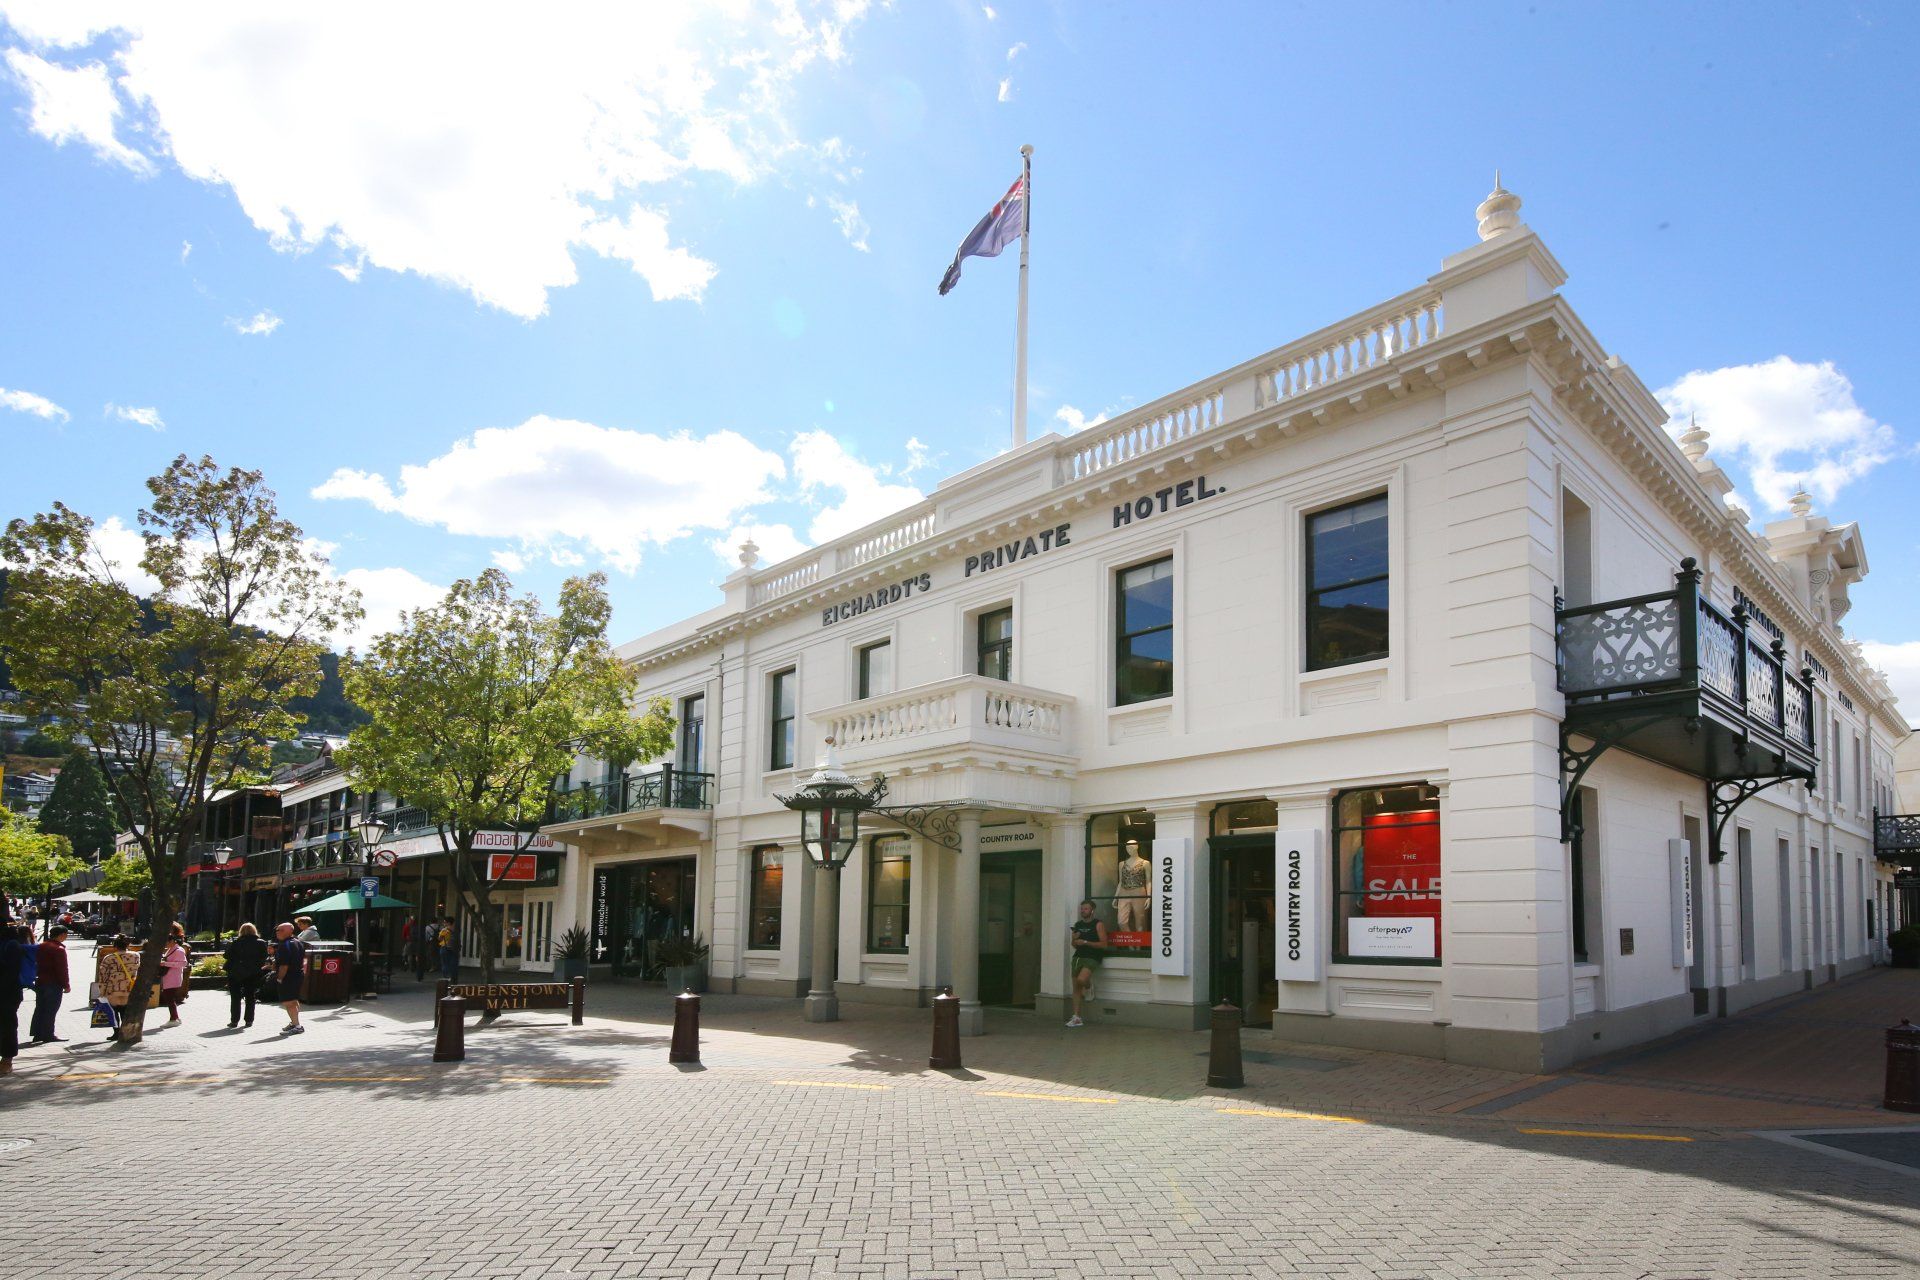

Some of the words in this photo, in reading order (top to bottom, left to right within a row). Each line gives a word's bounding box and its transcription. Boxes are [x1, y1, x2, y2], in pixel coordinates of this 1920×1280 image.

[822, 572, 931, 627] EICHARDT'S
[964, 523, 1071, 577] PRIVATE
[1113, 476, 1226, 528] HOTEL.
[980, 834, 1014, 844] COUNTRY
[1014, 832, 1035, 841] ROAD
[1162, 856, 1173, 893] ROAD
[1288, 850, 1301, 891] ROAD
[599, 876, 607, 897] world
[1368, 877, 1441, 901] SALE
[1162, 894, 1173, 958] COUNTRY
[1288, 892, 1301, 961] COUNTRY
[1367, 925, 1401, 935] afterpay
[452, 984, 567, 997] QUEENSTOWN
